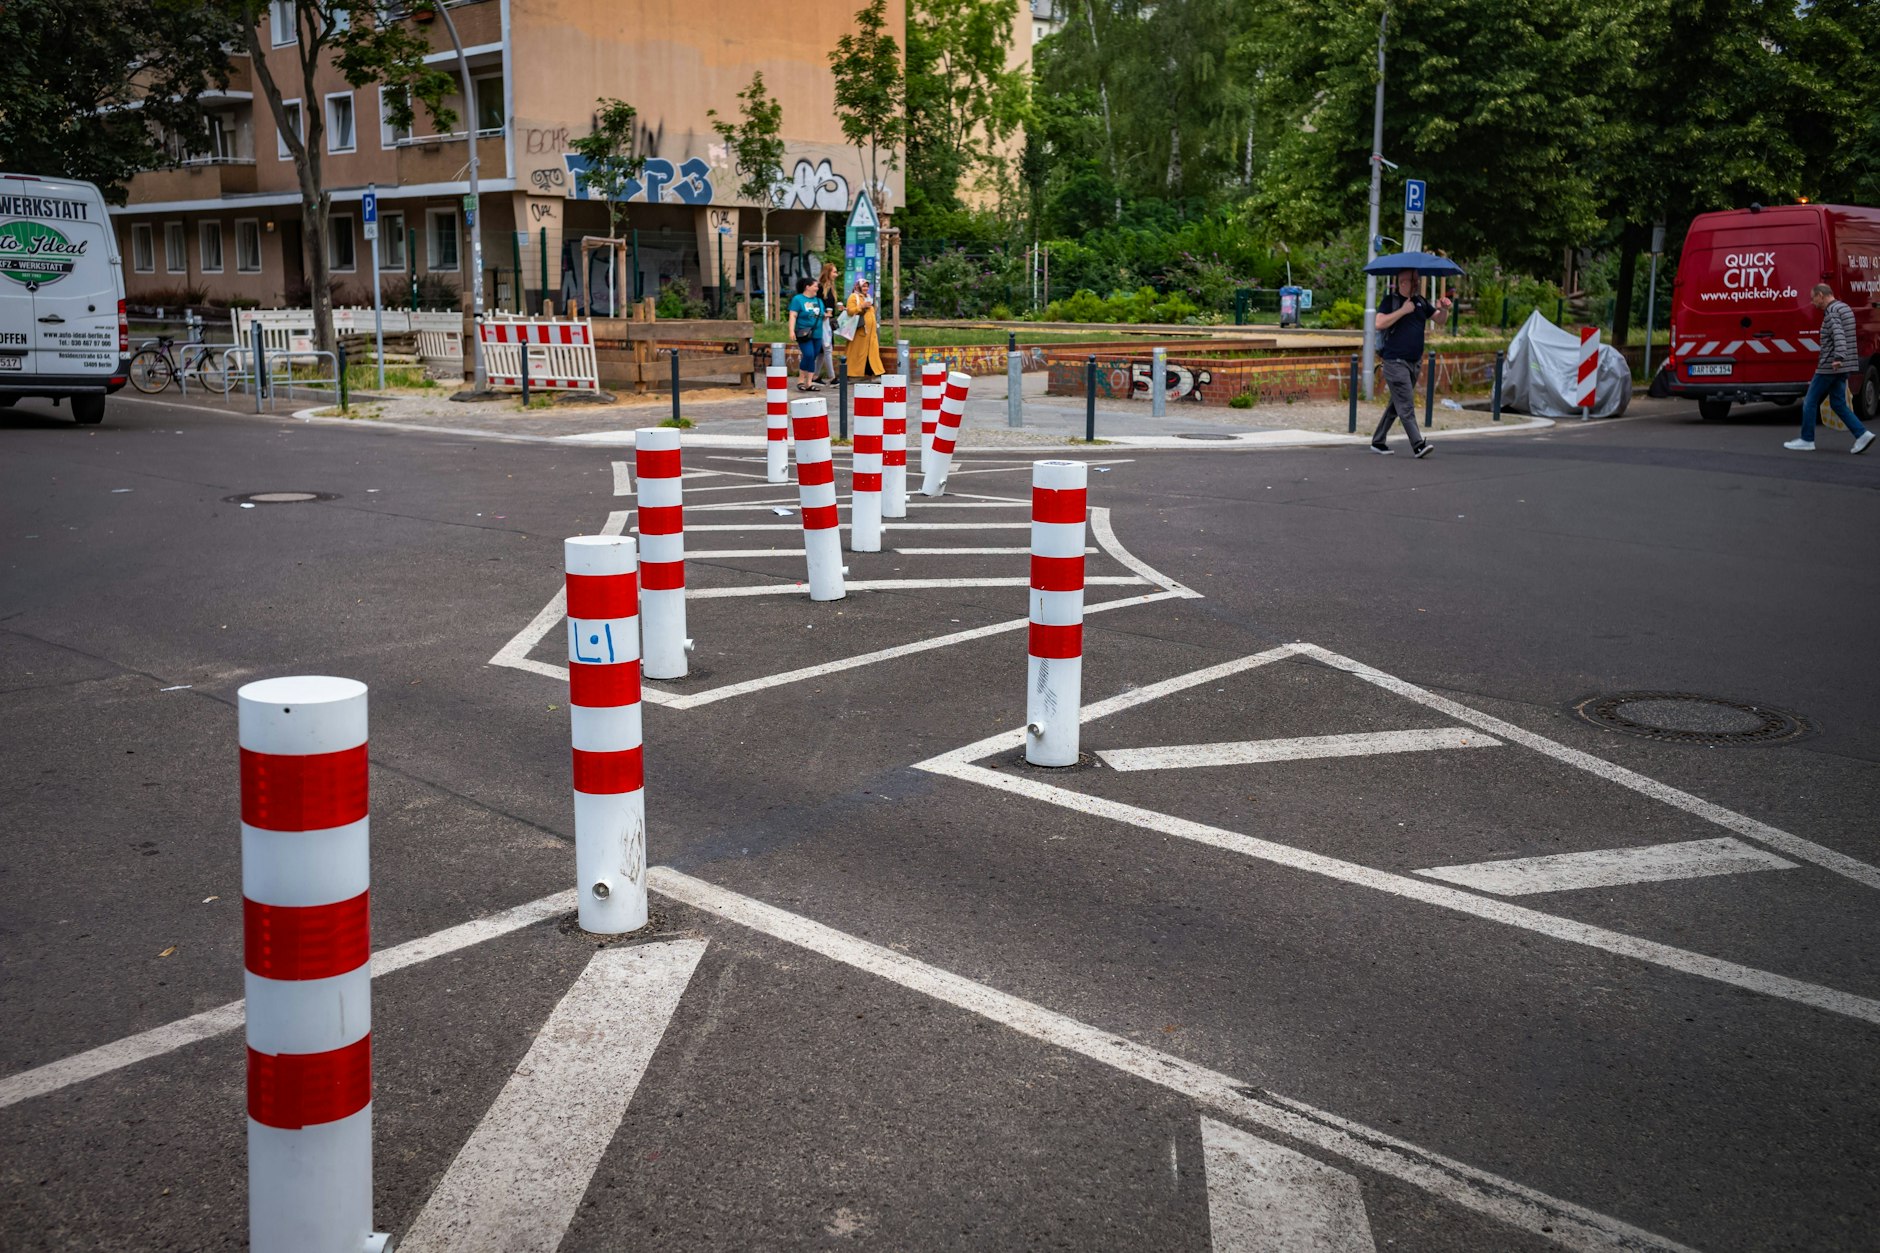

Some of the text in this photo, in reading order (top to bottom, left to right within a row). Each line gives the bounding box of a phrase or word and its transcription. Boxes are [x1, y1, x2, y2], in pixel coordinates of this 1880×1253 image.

[1409, 184, 1420, 208] P
[0, 196, 88, 220] WERKSTATT
[365, 196, 373, 219] P
[27, 235, 88, 255] Ideal
[18, 261, 64, 272] WERKSTATT
[1725, 251, 1775, 268] QUICK
[1723, 267, 1775, 289] CITY
[1700, 285, 1798, 303] www.quickcity.de
[0, 358, 17, 367] 517
